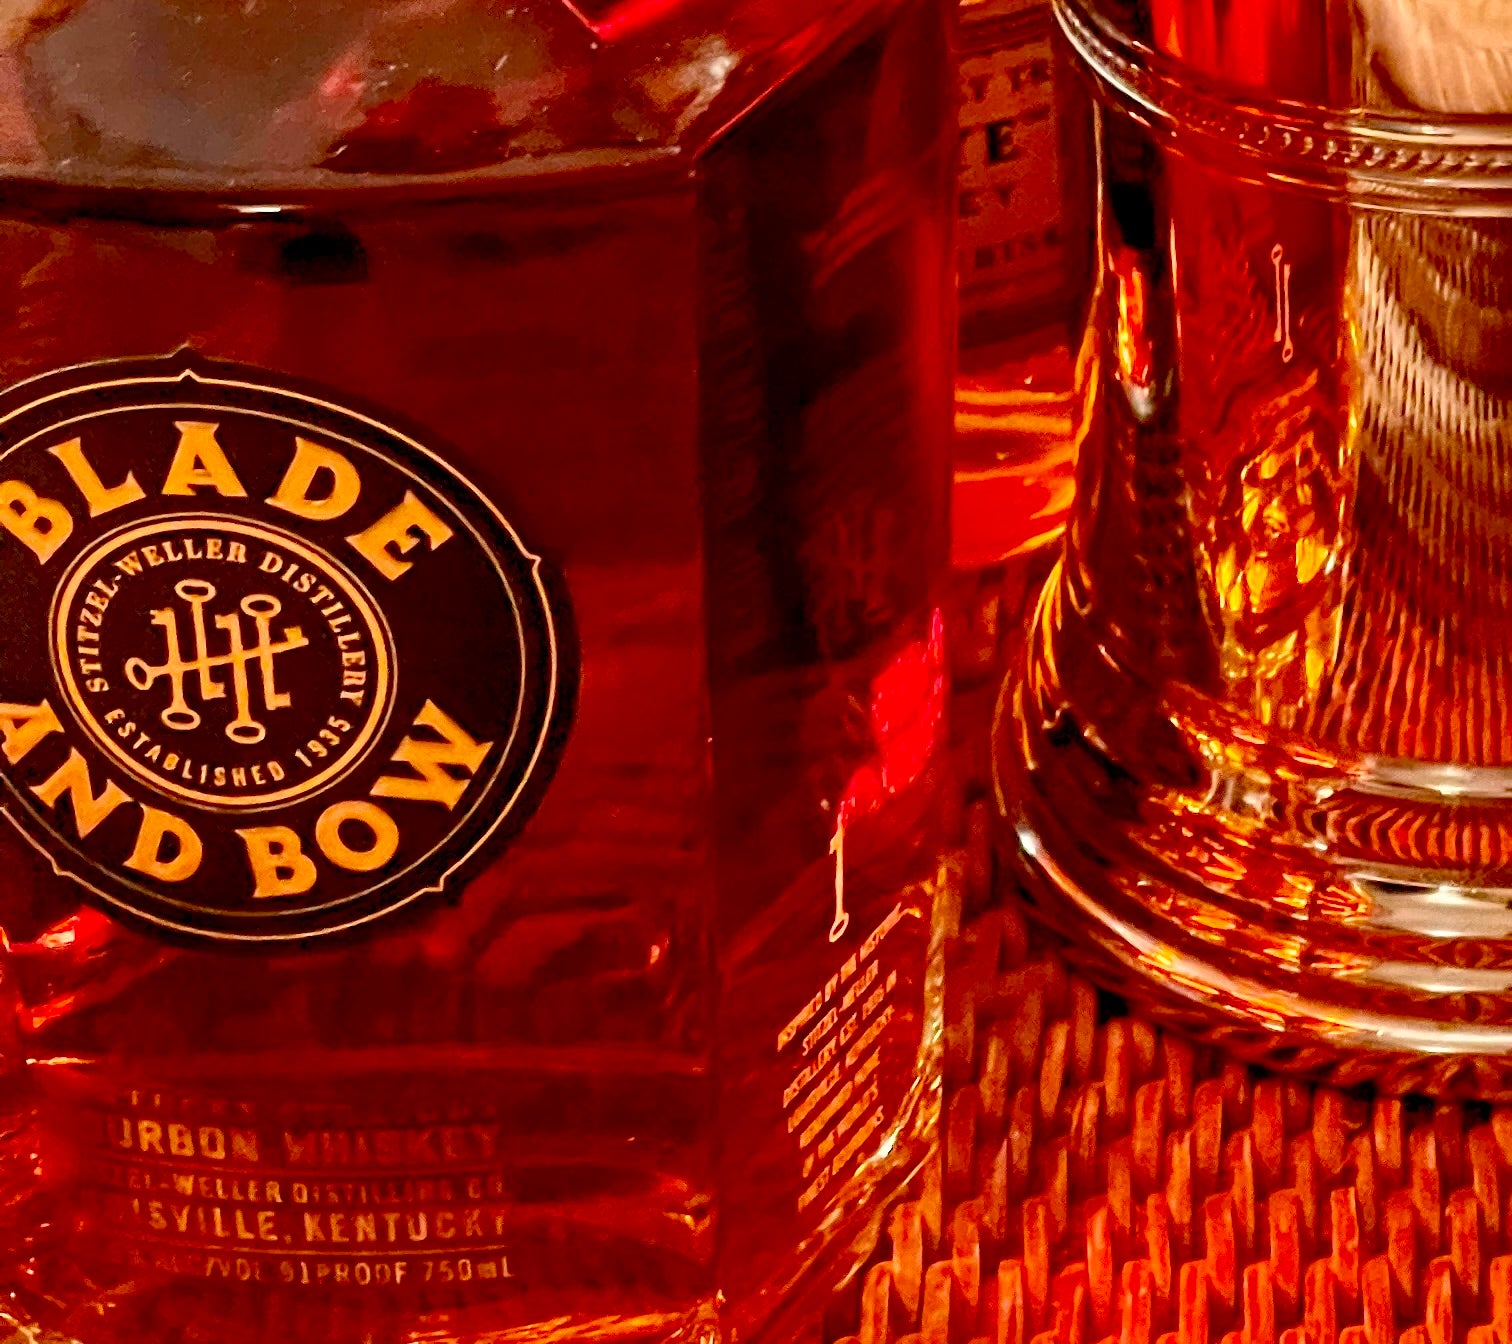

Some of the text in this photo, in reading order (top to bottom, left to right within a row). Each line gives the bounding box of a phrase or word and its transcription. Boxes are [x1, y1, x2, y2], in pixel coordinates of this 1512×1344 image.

[0, 420, 454, 582] BLADE
[77, 538, 368, 708] STITZEL-WELLER DISTILLERY
[0, 698, 494, 899] AND BOW
[103, 708, 352, 788] ESTABLISHED 1935
